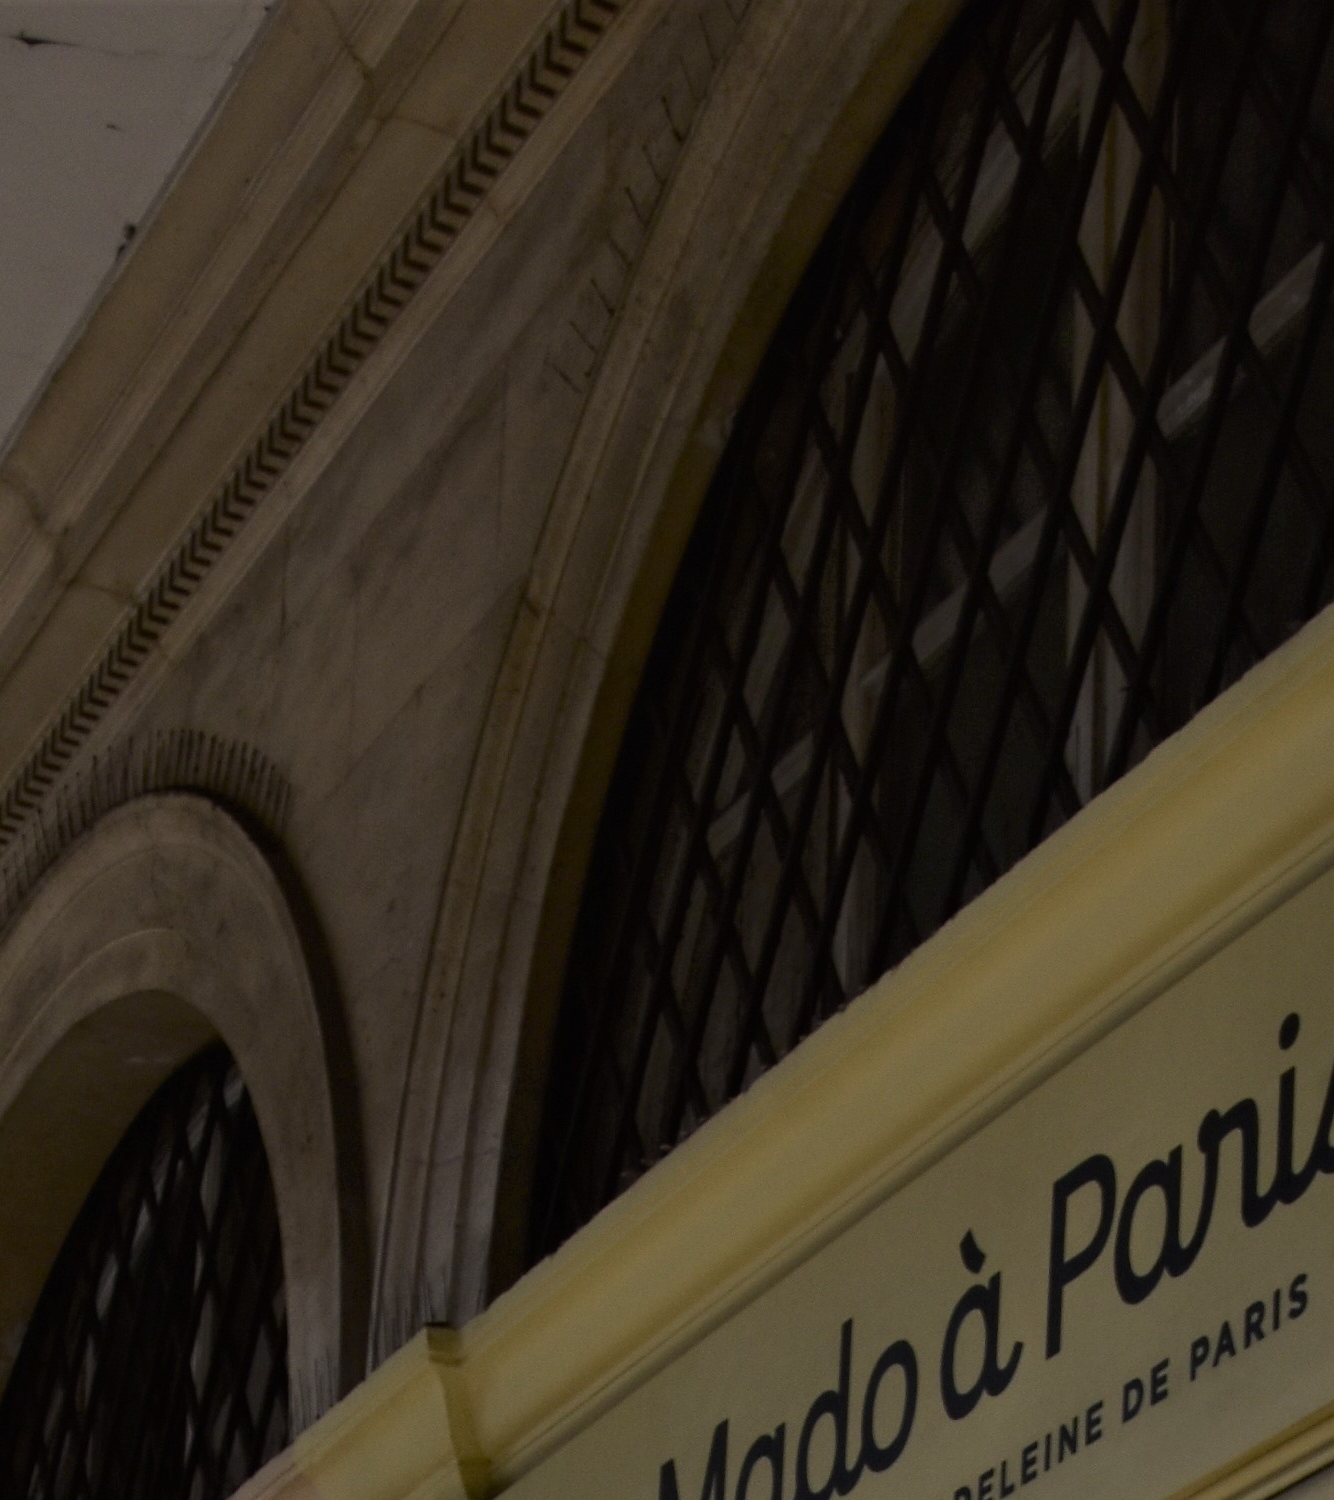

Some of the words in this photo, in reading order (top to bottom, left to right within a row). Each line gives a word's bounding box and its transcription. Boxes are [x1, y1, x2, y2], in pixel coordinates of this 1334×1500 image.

[939, 1229, 1024, 1421] à
[1121, 1358, 1171, 1425] DE
[1189, 1272, 1310, 1382] PARIS
